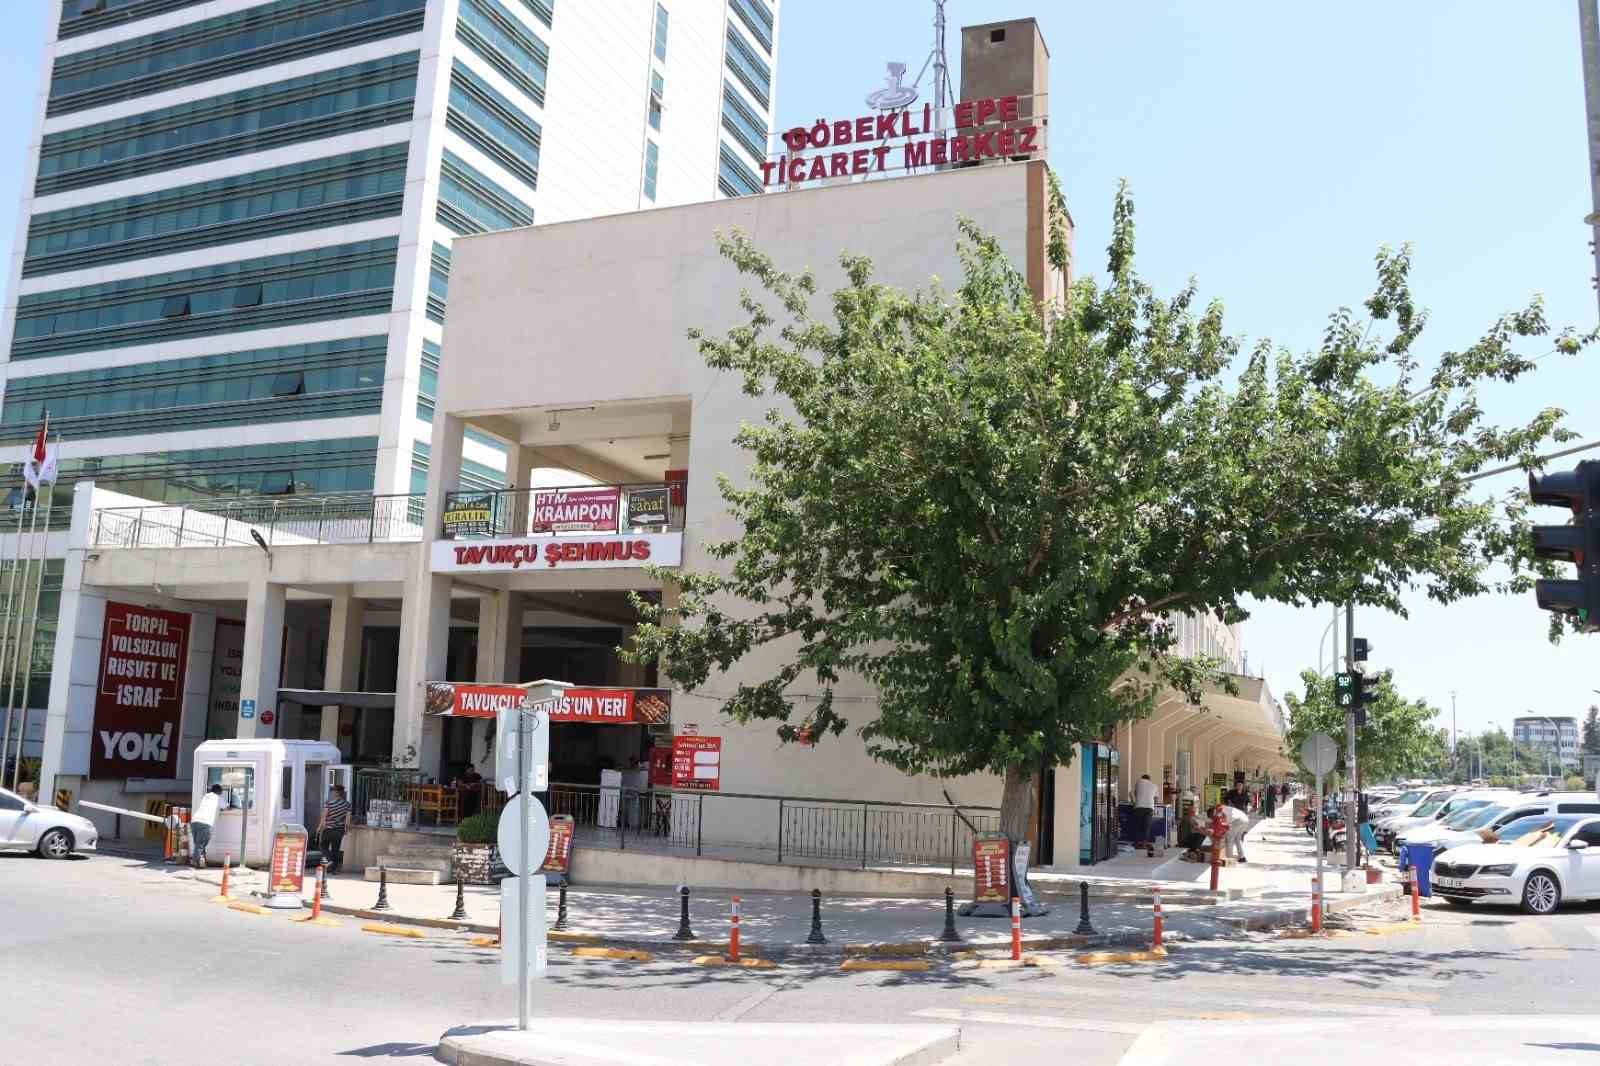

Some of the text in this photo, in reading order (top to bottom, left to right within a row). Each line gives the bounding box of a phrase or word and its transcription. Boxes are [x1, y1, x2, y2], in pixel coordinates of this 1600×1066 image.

[759, 126, 1038, 187] TİCARET MERKEZ
[536, 493, 567, 505] HTM
[535, 504, 613, 522] KRAMPON
[454, 540, 651, 569] TAVUKÇU ŞEHMUS
[125, 613, 169, 636] TORPİL
[111, 635, 178, 659] YOLSUZLUK
[107, 657, 176, 682] RÜŞVET VE
[116, 685, 163, 708] İSRAF
[596, 693, 628, 717] YERİ
[99, 722, 174, 762] YOK!
